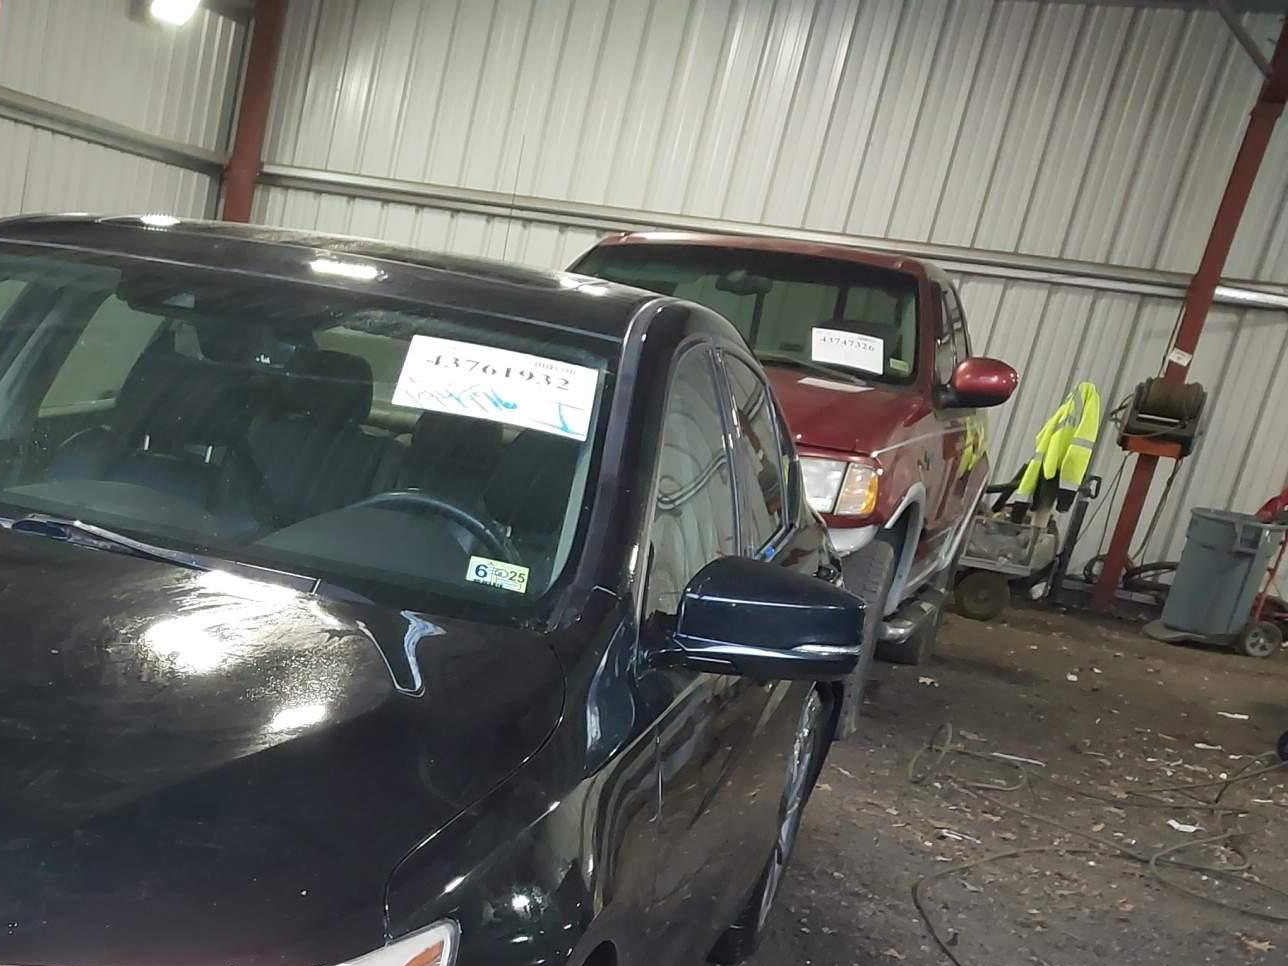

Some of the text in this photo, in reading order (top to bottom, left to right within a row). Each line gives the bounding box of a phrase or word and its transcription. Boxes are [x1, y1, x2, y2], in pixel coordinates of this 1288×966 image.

[425, 354, 570, 391] 43761932
[474, 563, 489, 578] 6
[508, 570, 526, 584] 25
